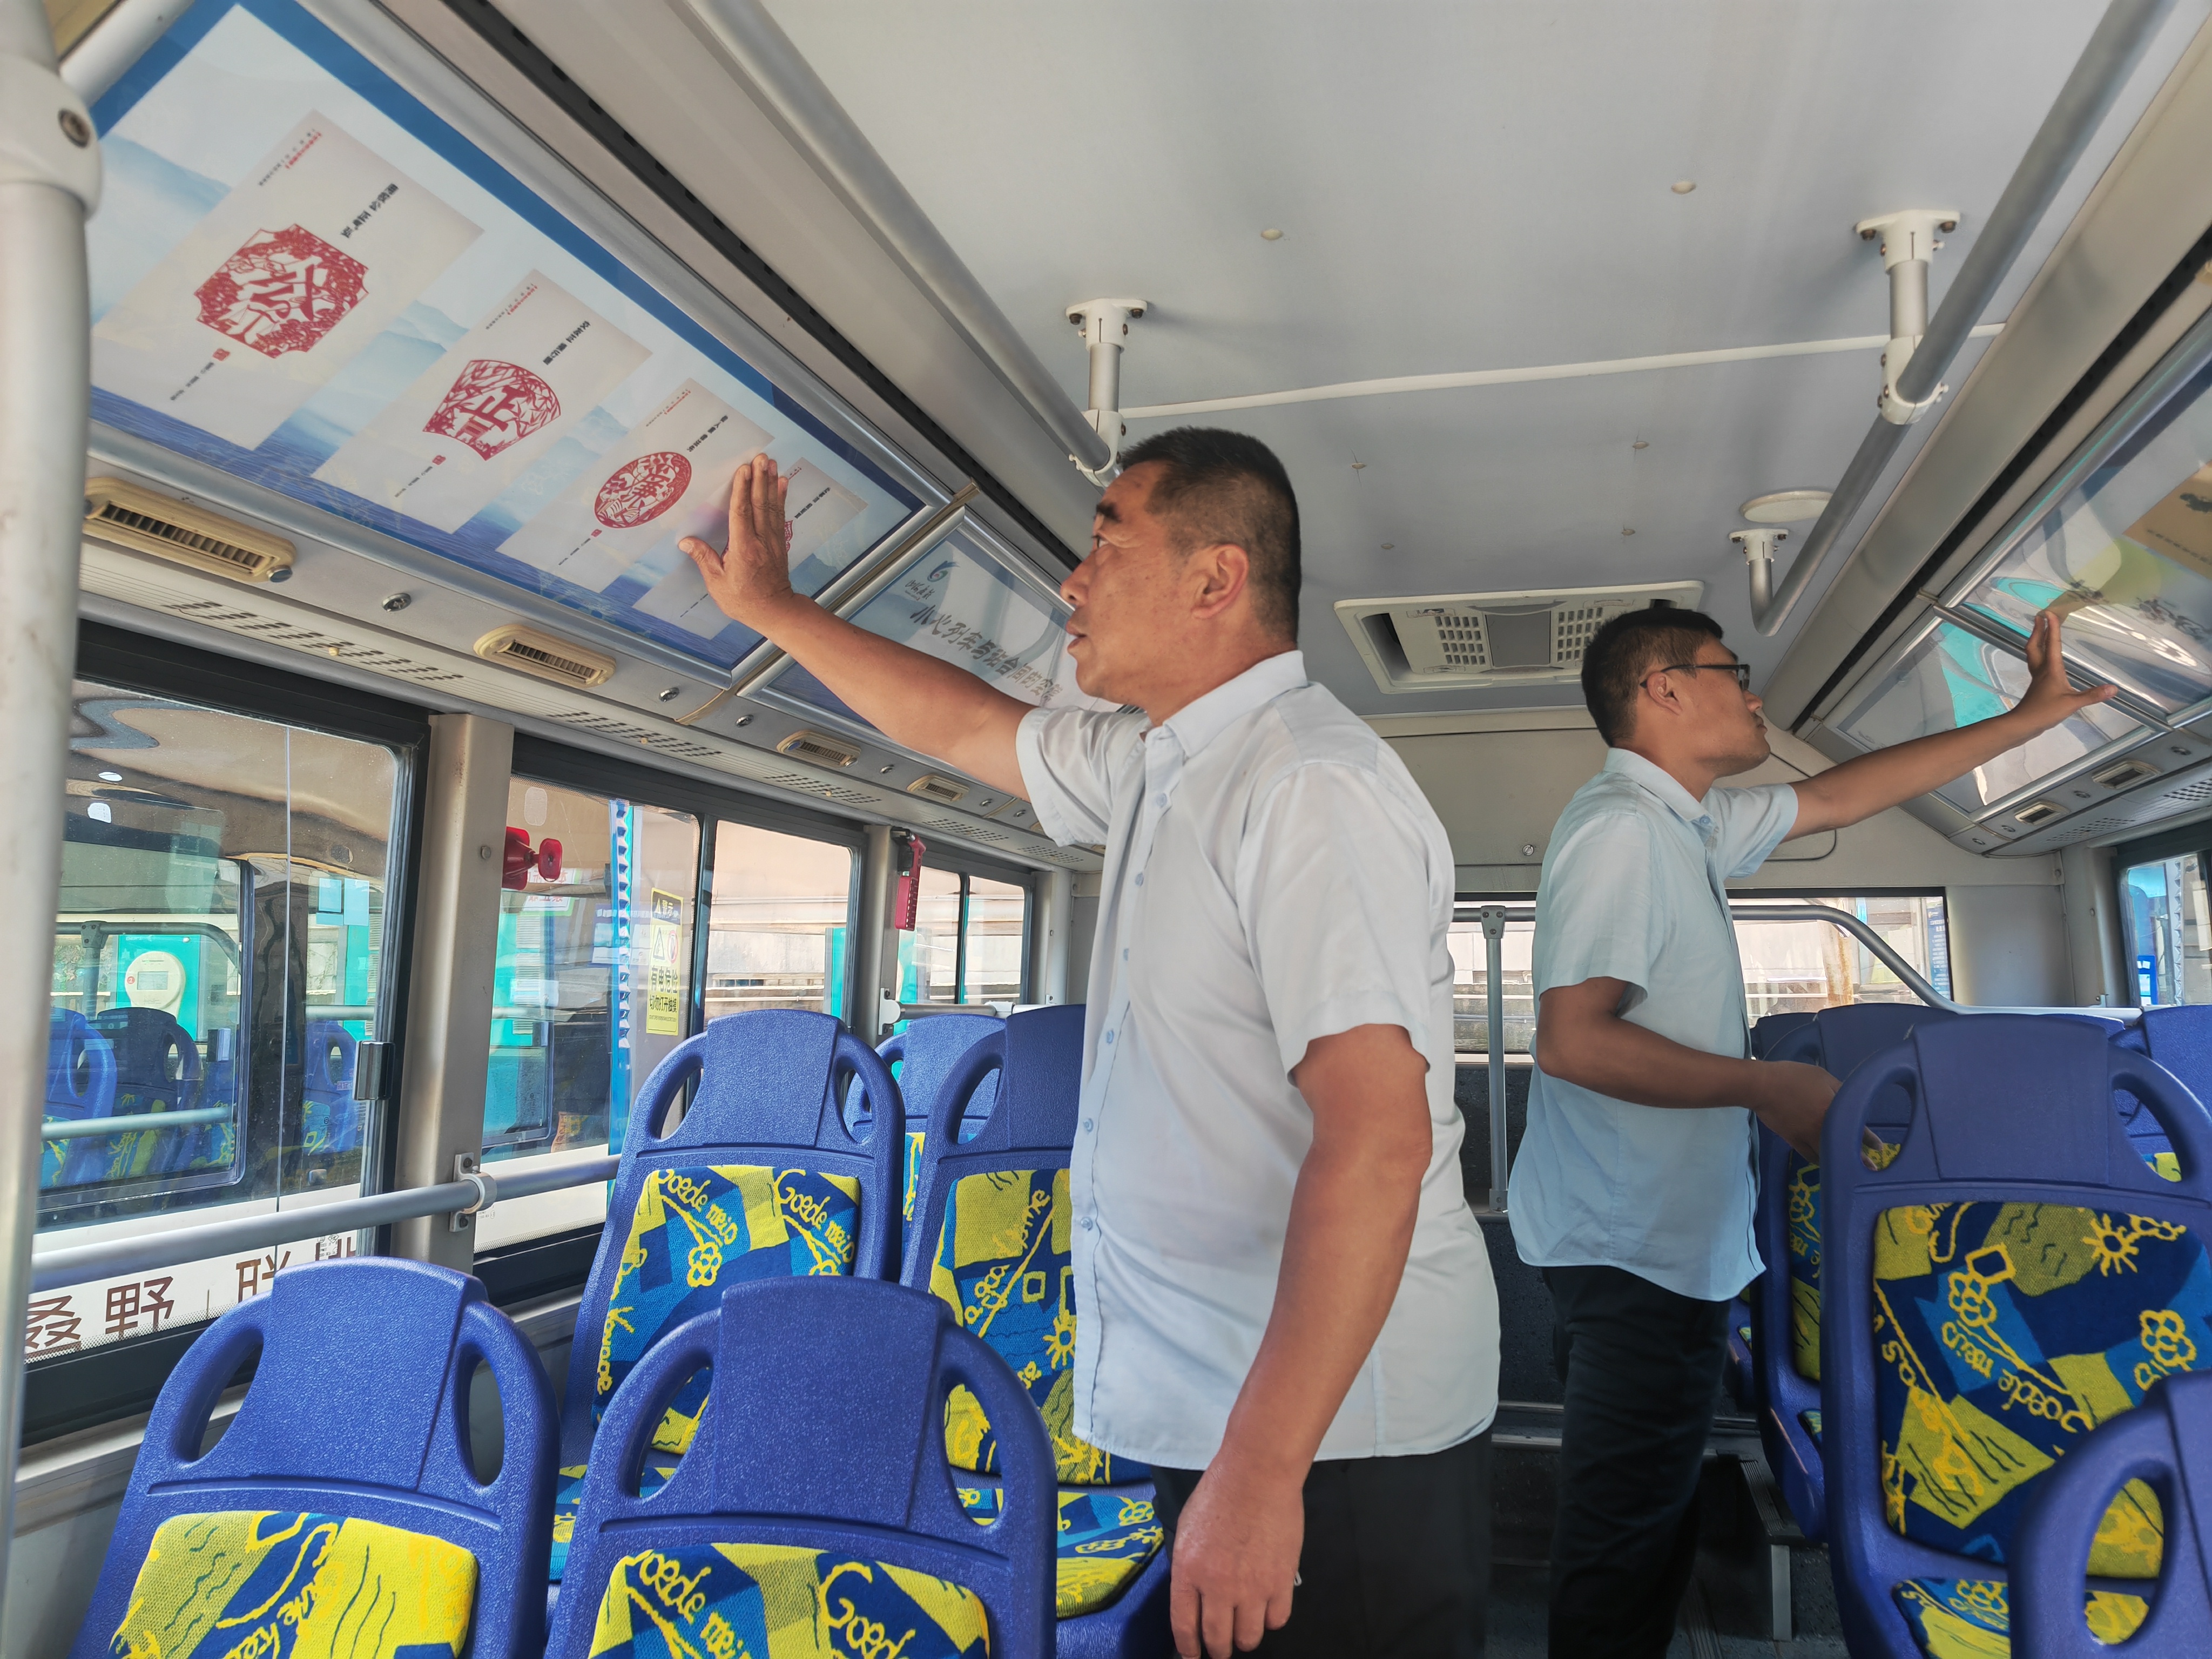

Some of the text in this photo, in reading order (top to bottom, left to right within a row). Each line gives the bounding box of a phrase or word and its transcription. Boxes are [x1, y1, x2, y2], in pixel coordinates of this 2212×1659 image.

[460, 386, 526, 431] 正
[910, 604, 1063, 702] 小心列车与站台间的空隙
[662, 899, 674, 916] 警示
[651, 965, 678, 993] 有电危险
[650, 994, 677, 1013] 切勿打开触摸
